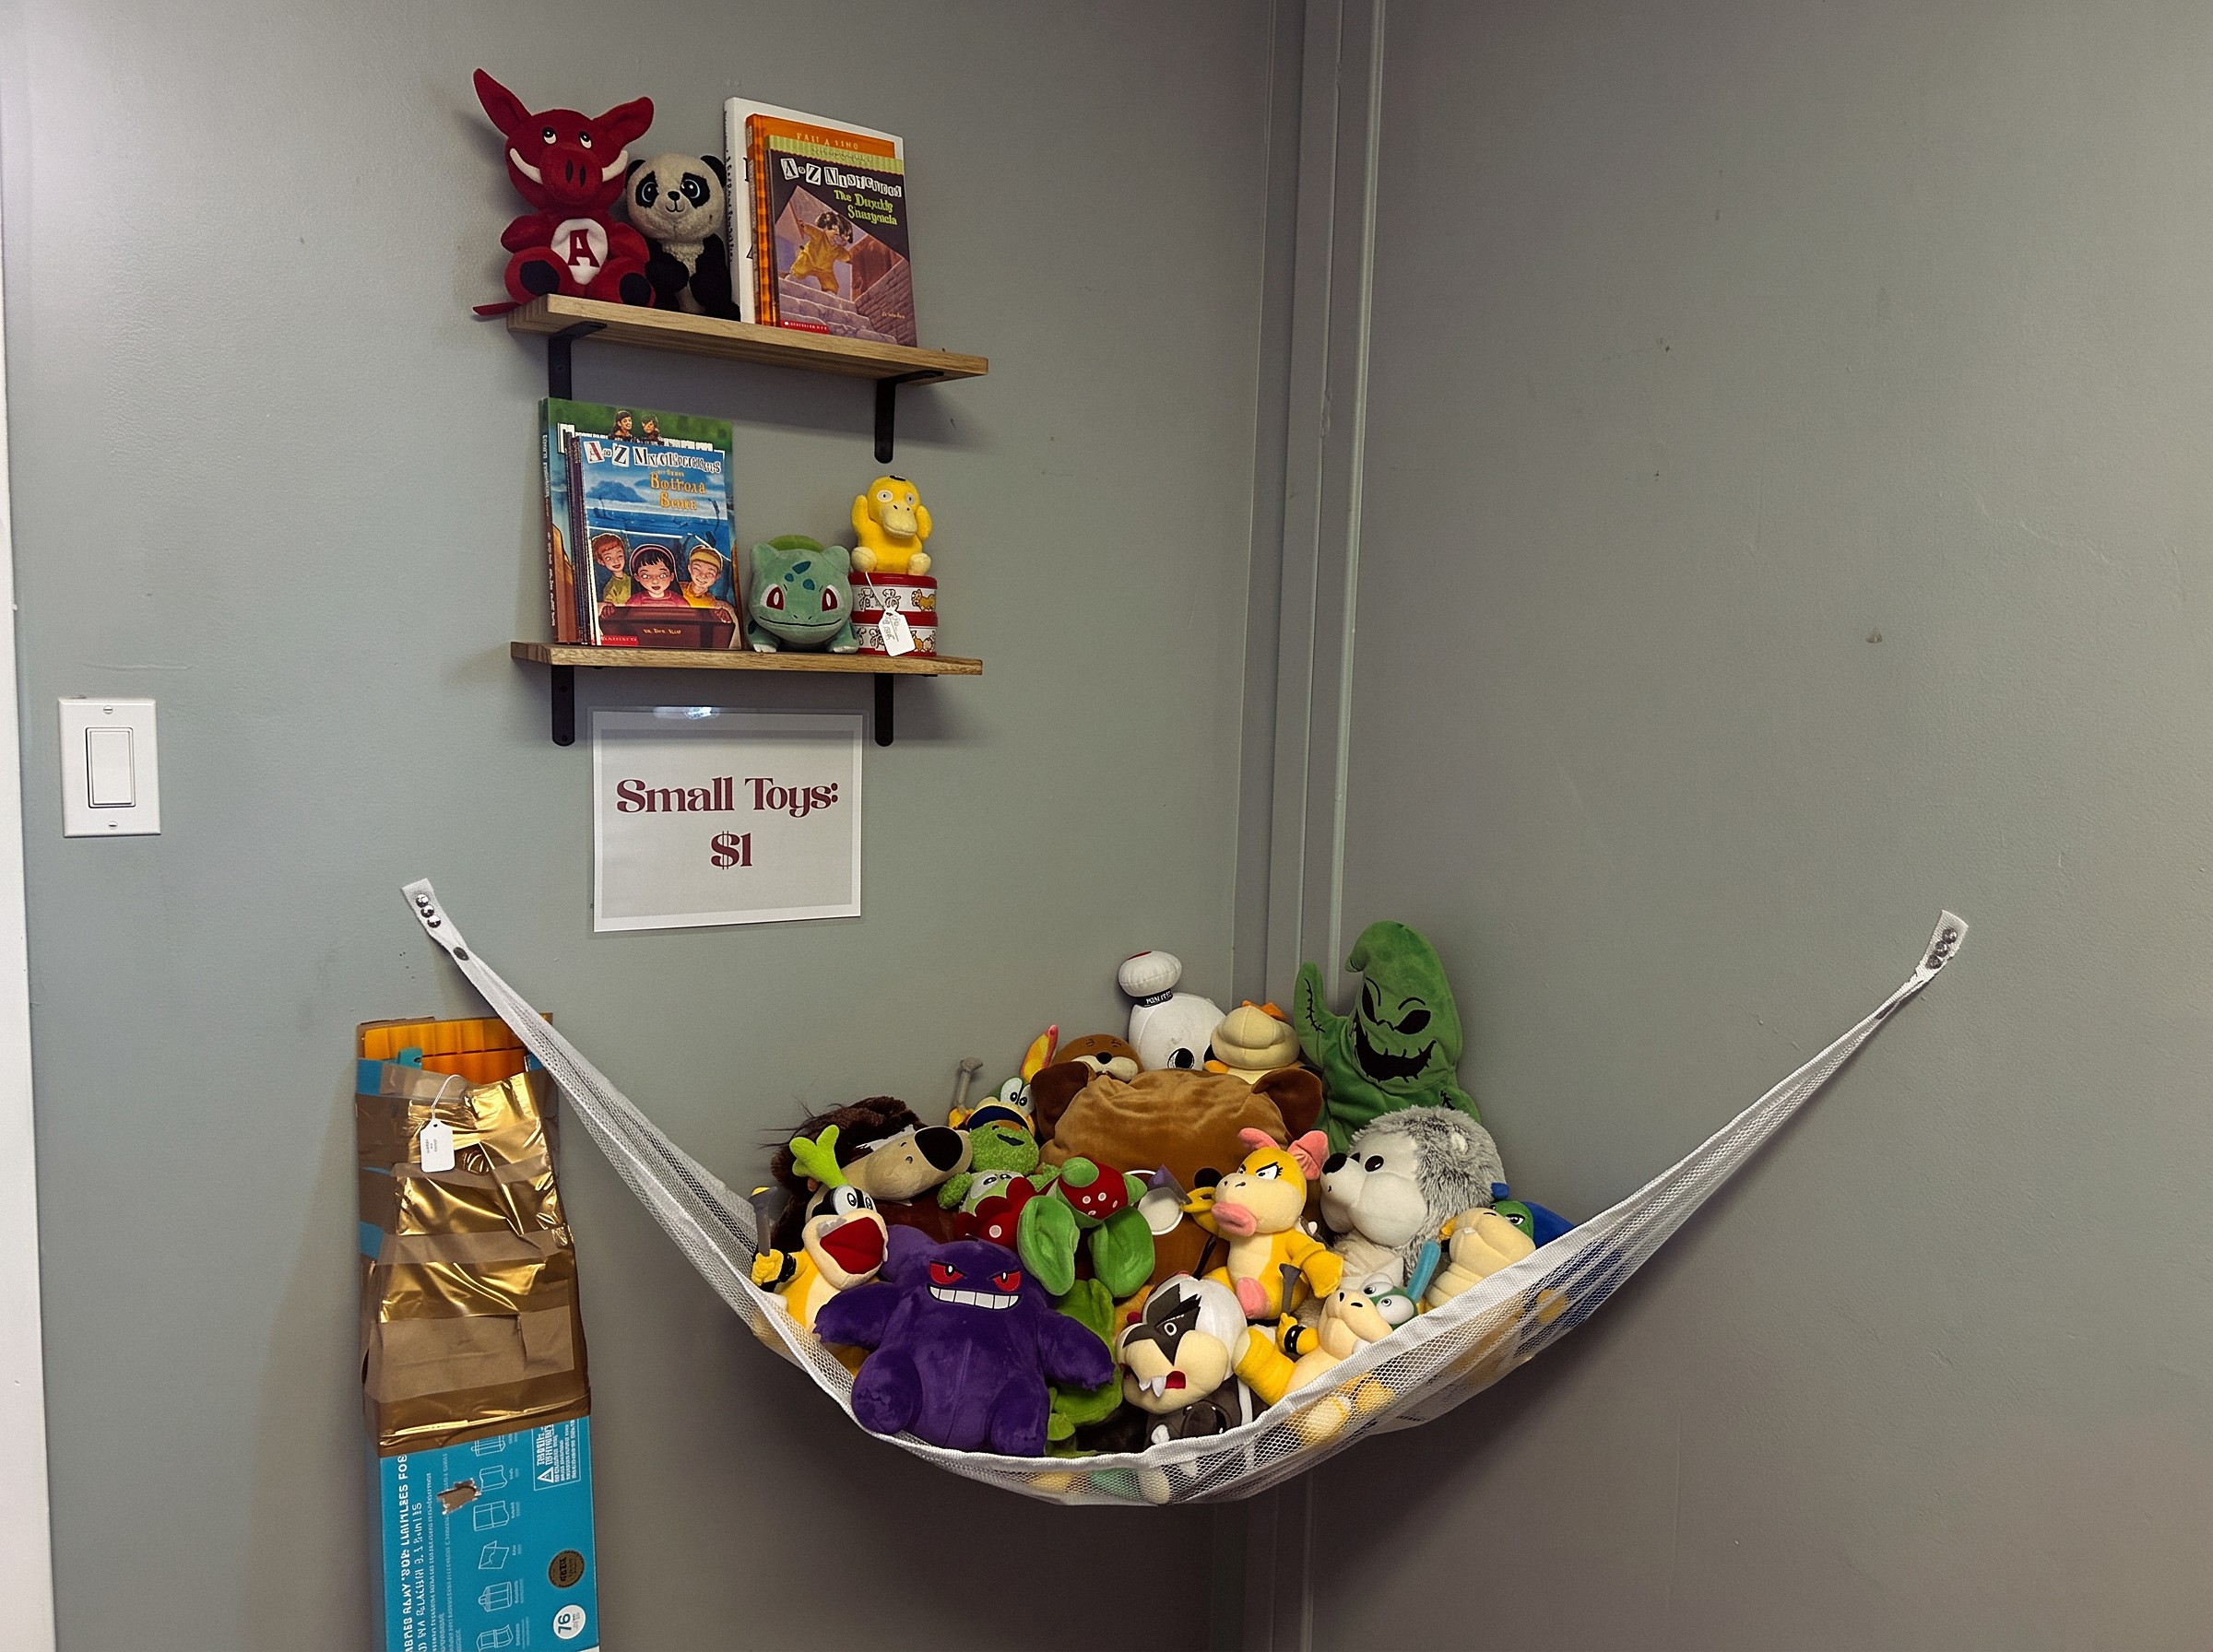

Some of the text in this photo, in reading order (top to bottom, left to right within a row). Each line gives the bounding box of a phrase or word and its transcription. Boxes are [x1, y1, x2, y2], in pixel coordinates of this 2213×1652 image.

[567, 229, 600, 267] A
[616, 776, 839, 818] Small Toys:
[710, 830, 752, 869] $1
[557, 1613, 572, 1634] 76
